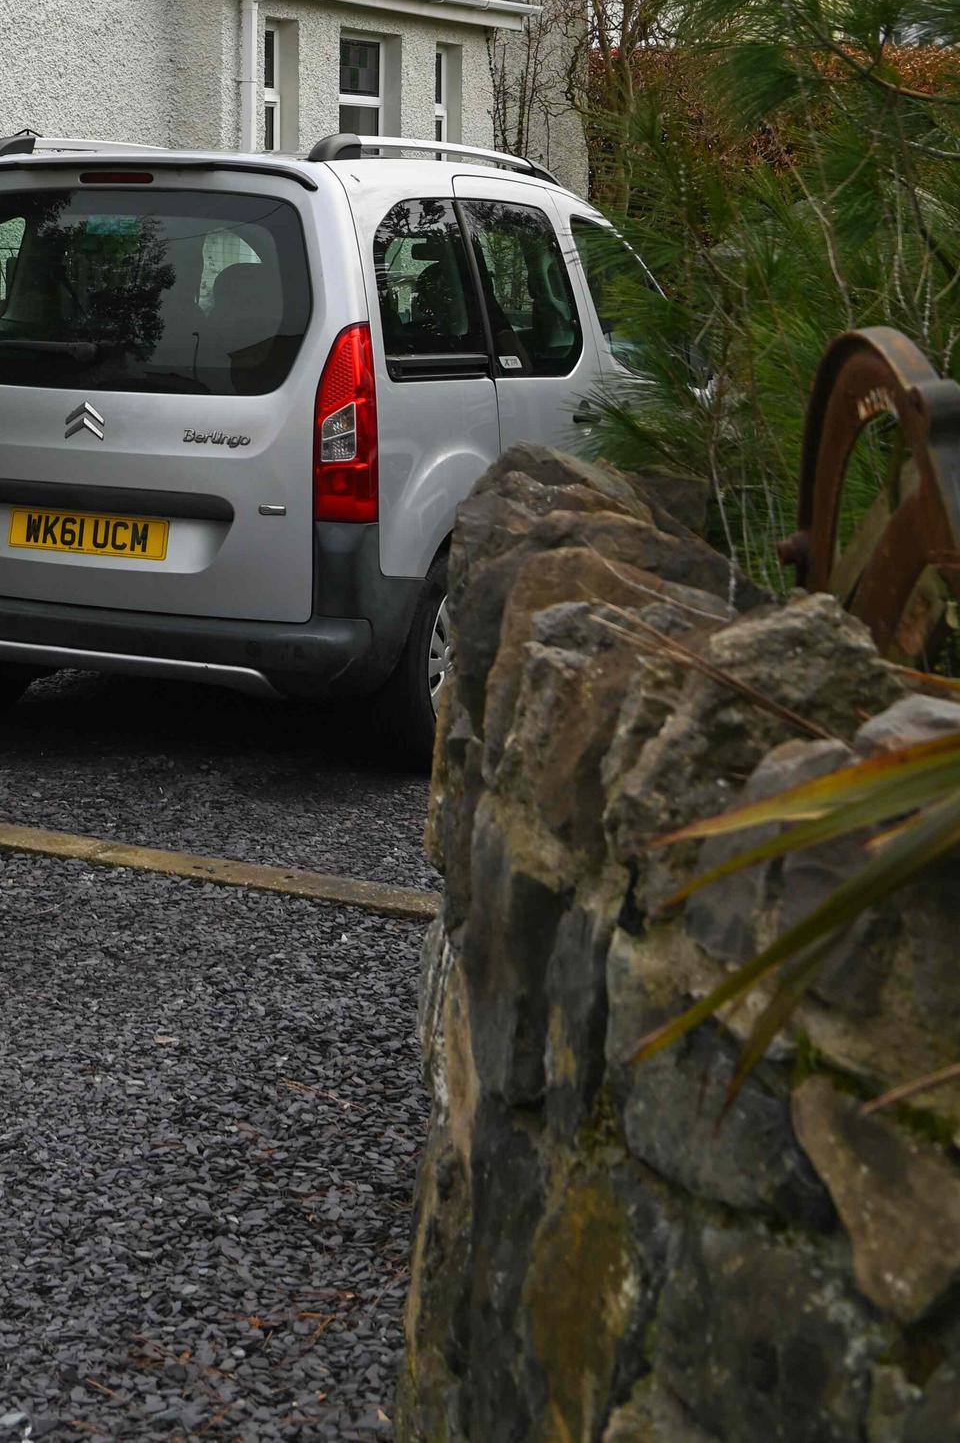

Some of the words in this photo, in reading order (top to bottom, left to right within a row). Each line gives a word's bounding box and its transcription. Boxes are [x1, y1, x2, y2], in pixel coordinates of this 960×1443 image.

[183, 429, 251, 448] Berlingo
[25, 514, 85, 547] WK61
[92, 520, 149, 553] UCM
